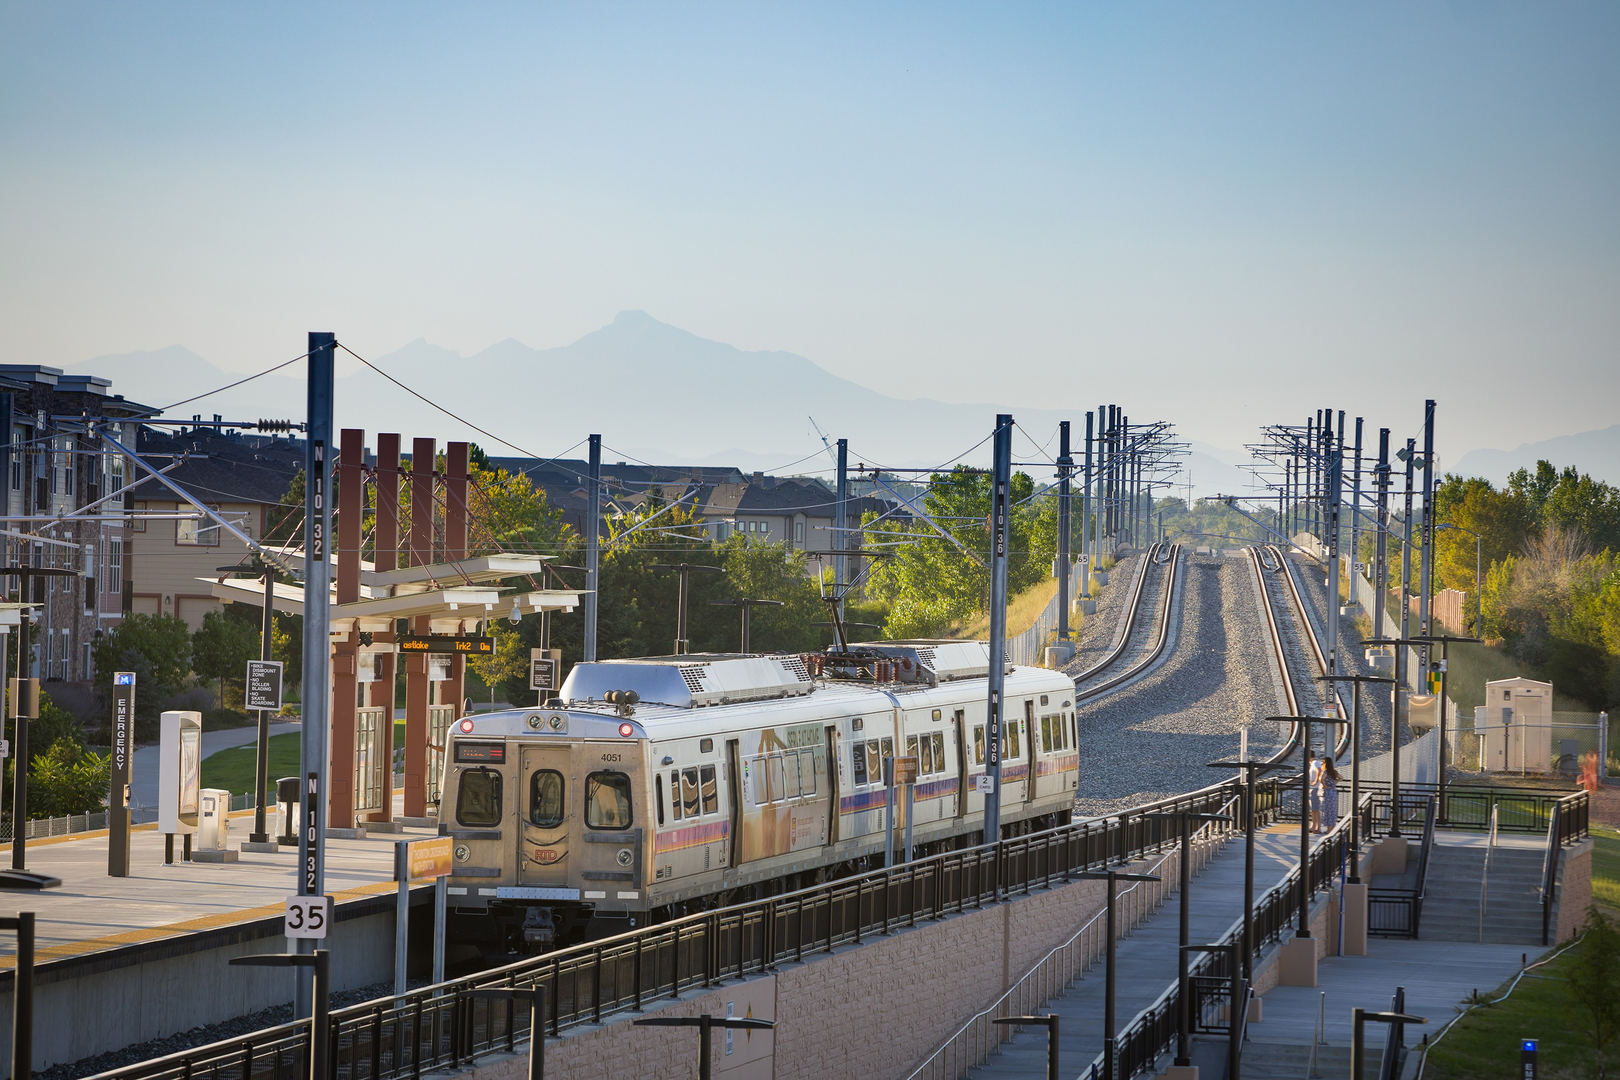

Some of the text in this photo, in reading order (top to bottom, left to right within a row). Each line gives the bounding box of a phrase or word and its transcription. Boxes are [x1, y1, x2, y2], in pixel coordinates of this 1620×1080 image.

[999, 485, 1004, 494] N
[314, 446, 323, 554] N 10-32
[455, 641, 472, 650] Trk2
[992, 694, 998, 703] N
[116, 699, 126, 770] EMERGENCY
[601, 754, 622, 762] 4051
[307, 778, 317, 887] N 10-32
[535, 849, 558, 860] RTD
[288, 904, 324, 930] 35
